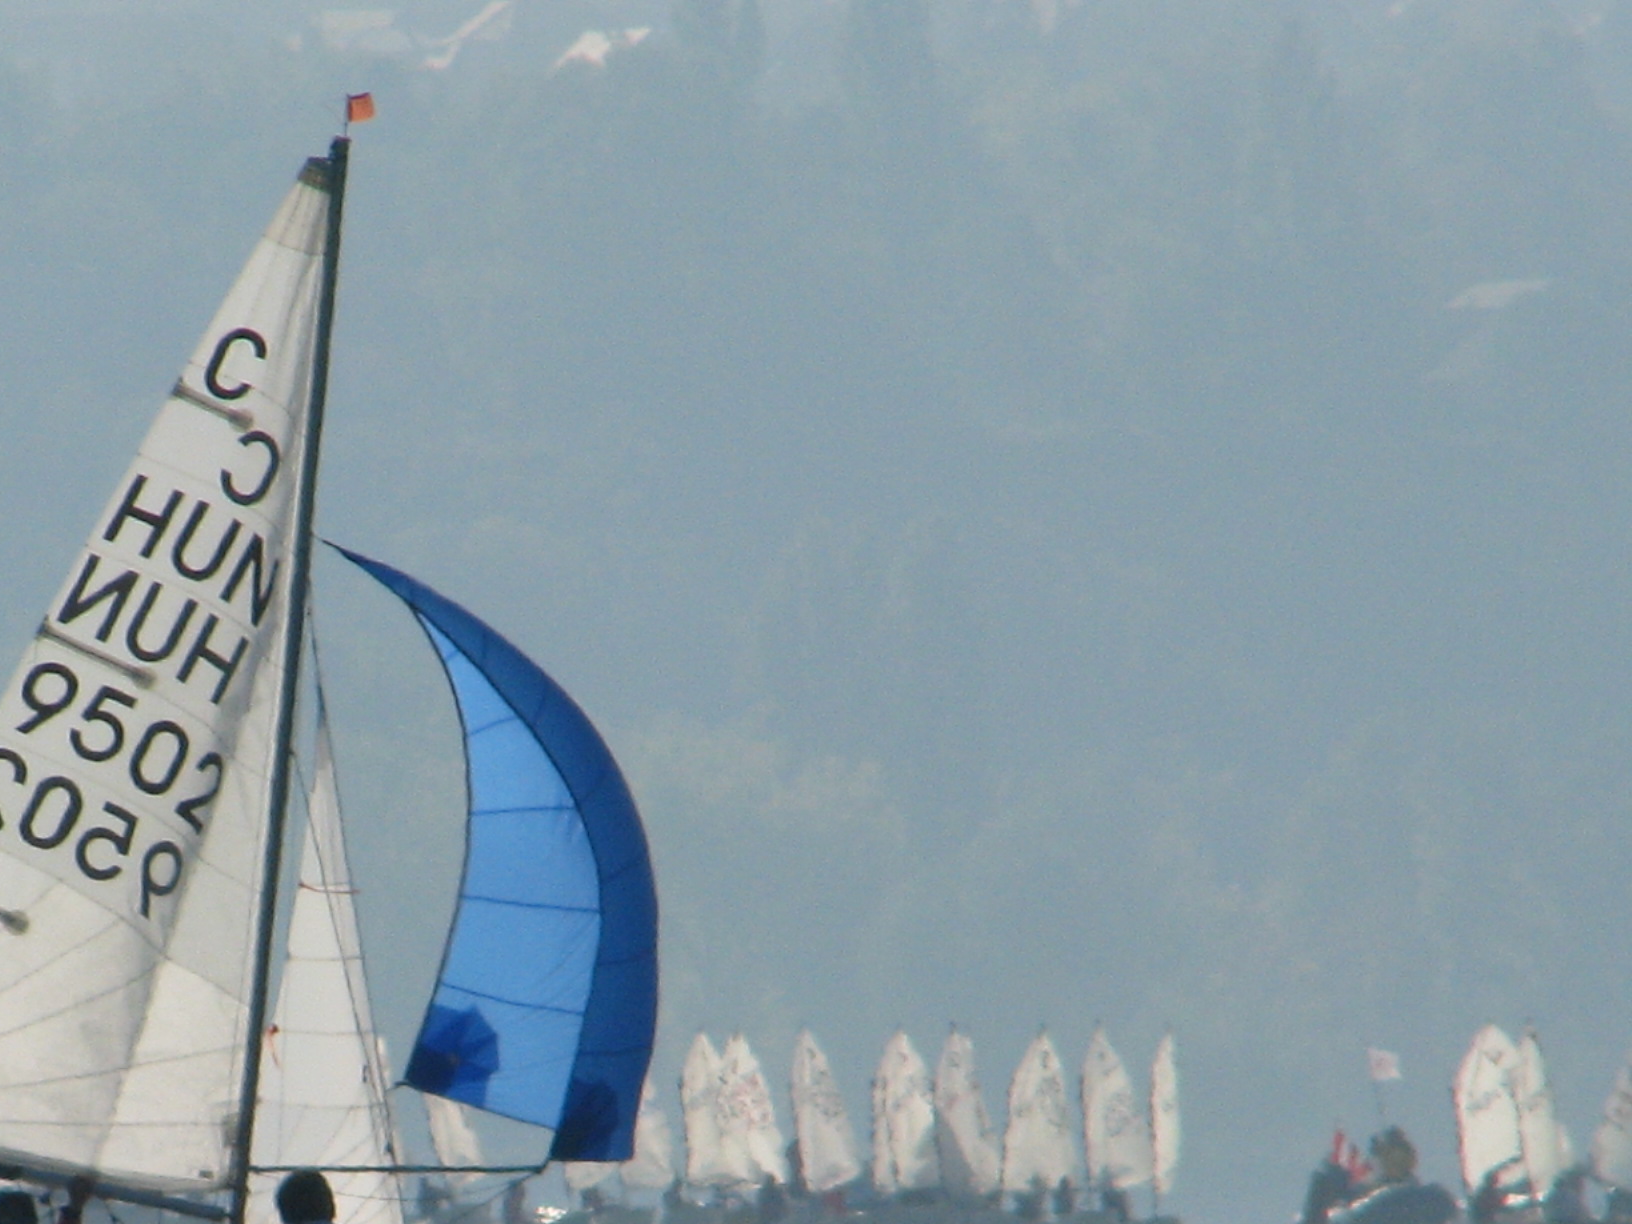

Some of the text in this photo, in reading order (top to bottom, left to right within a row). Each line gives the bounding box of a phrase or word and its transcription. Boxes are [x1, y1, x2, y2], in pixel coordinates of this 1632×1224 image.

[205, 328, 266, 400] C
[103, 475, 279, 628] HUN
[16, 661, 225, 834] 9502
